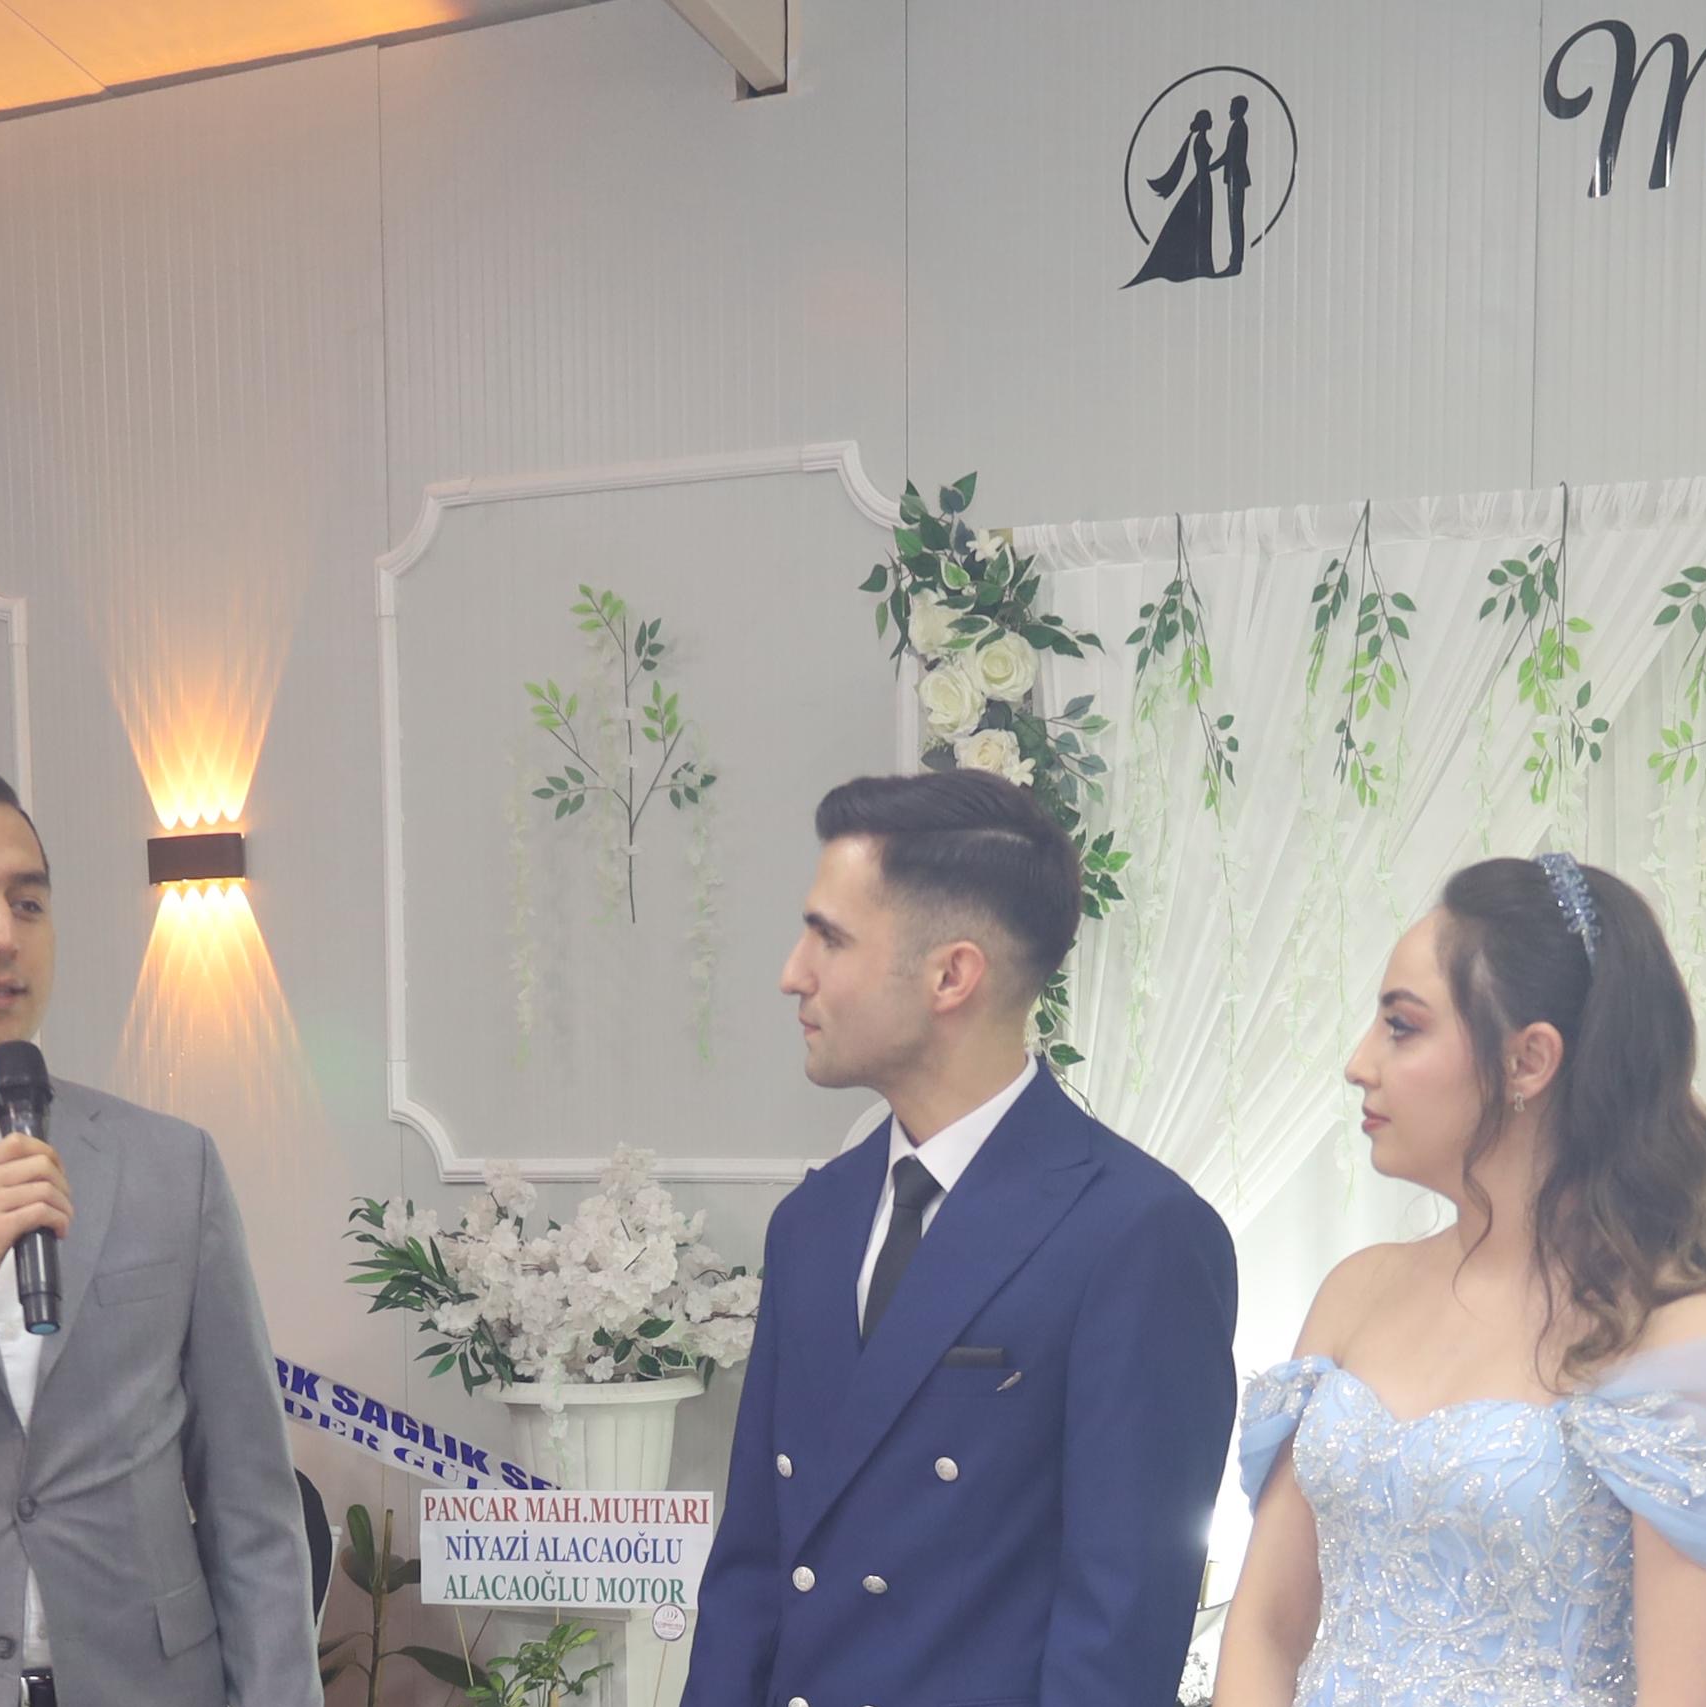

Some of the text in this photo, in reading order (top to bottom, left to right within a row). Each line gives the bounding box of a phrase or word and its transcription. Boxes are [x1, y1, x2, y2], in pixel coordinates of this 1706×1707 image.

[423, 1496, 710, 1526] PANCAR MAH.MUHTARI
[445, 1529, 684, 1565] NİYAZİ ALACAOĞLU
[442, 1569, 688, 1606] ALACAOĞLU MOTOR
